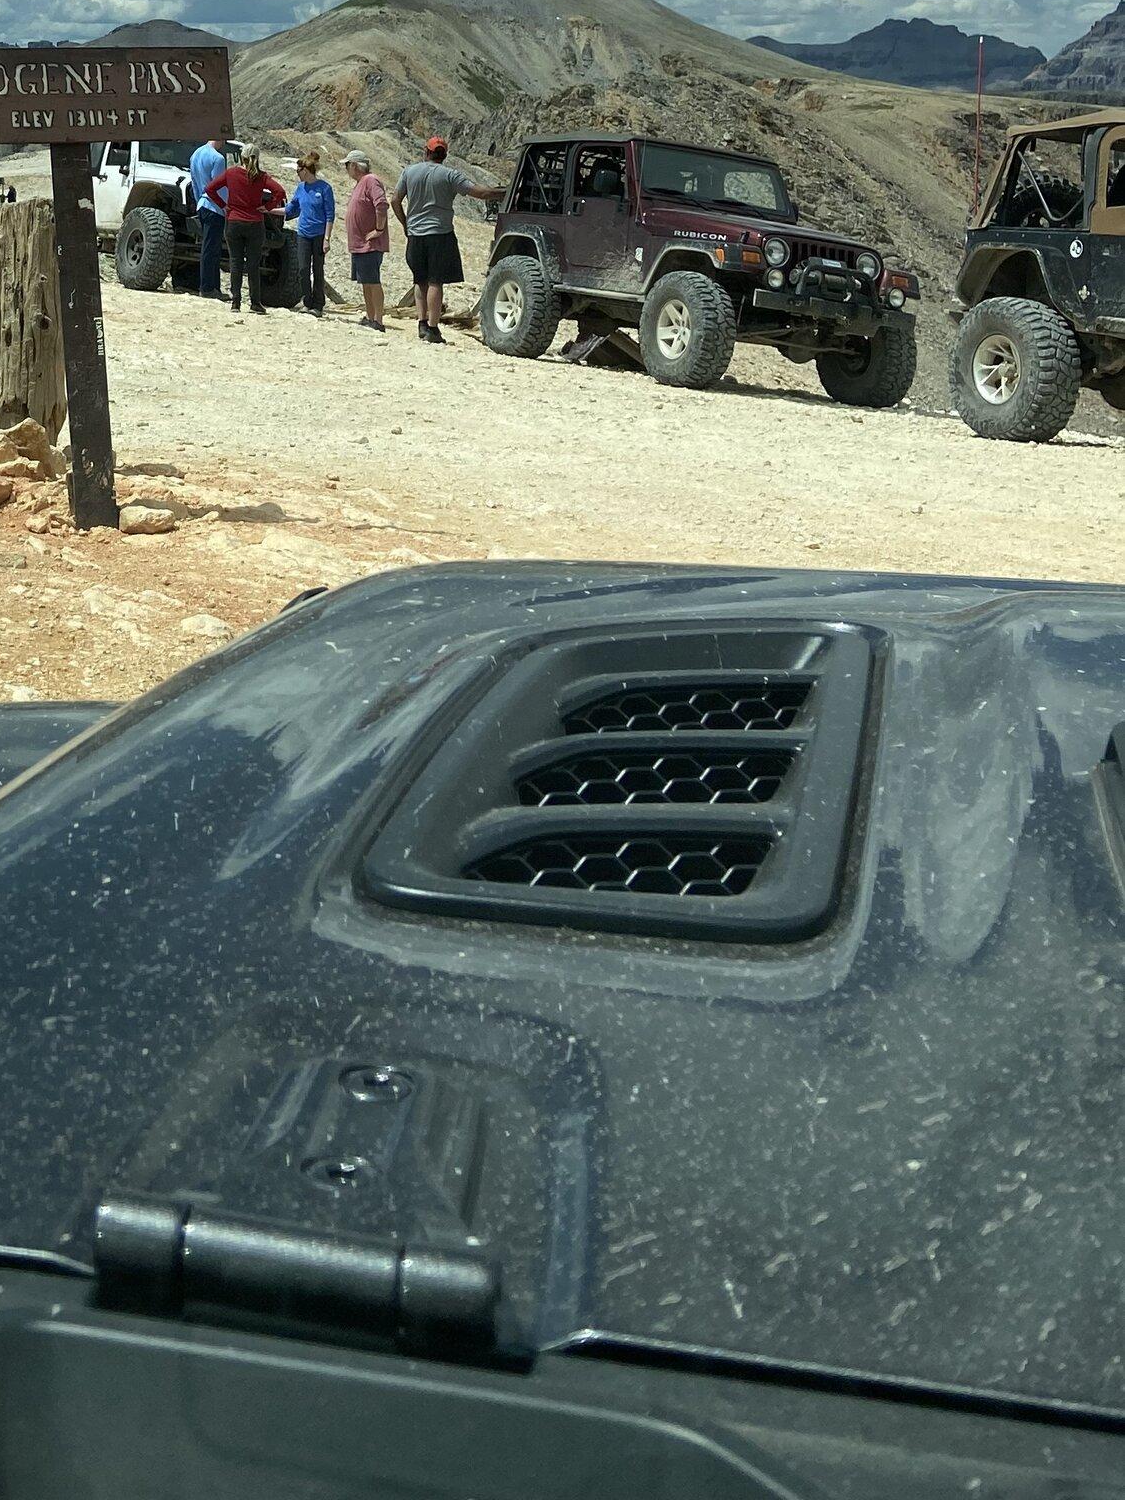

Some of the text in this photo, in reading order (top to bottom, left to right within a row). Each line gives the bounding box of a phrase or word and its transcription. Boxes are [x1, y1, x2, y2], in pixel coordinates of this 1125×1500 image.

[128, 61, 207, 94] PASS
[11, 108, 148, 128] ELEV 13114 FT
[673, 230, 727, 241] RUBICON
